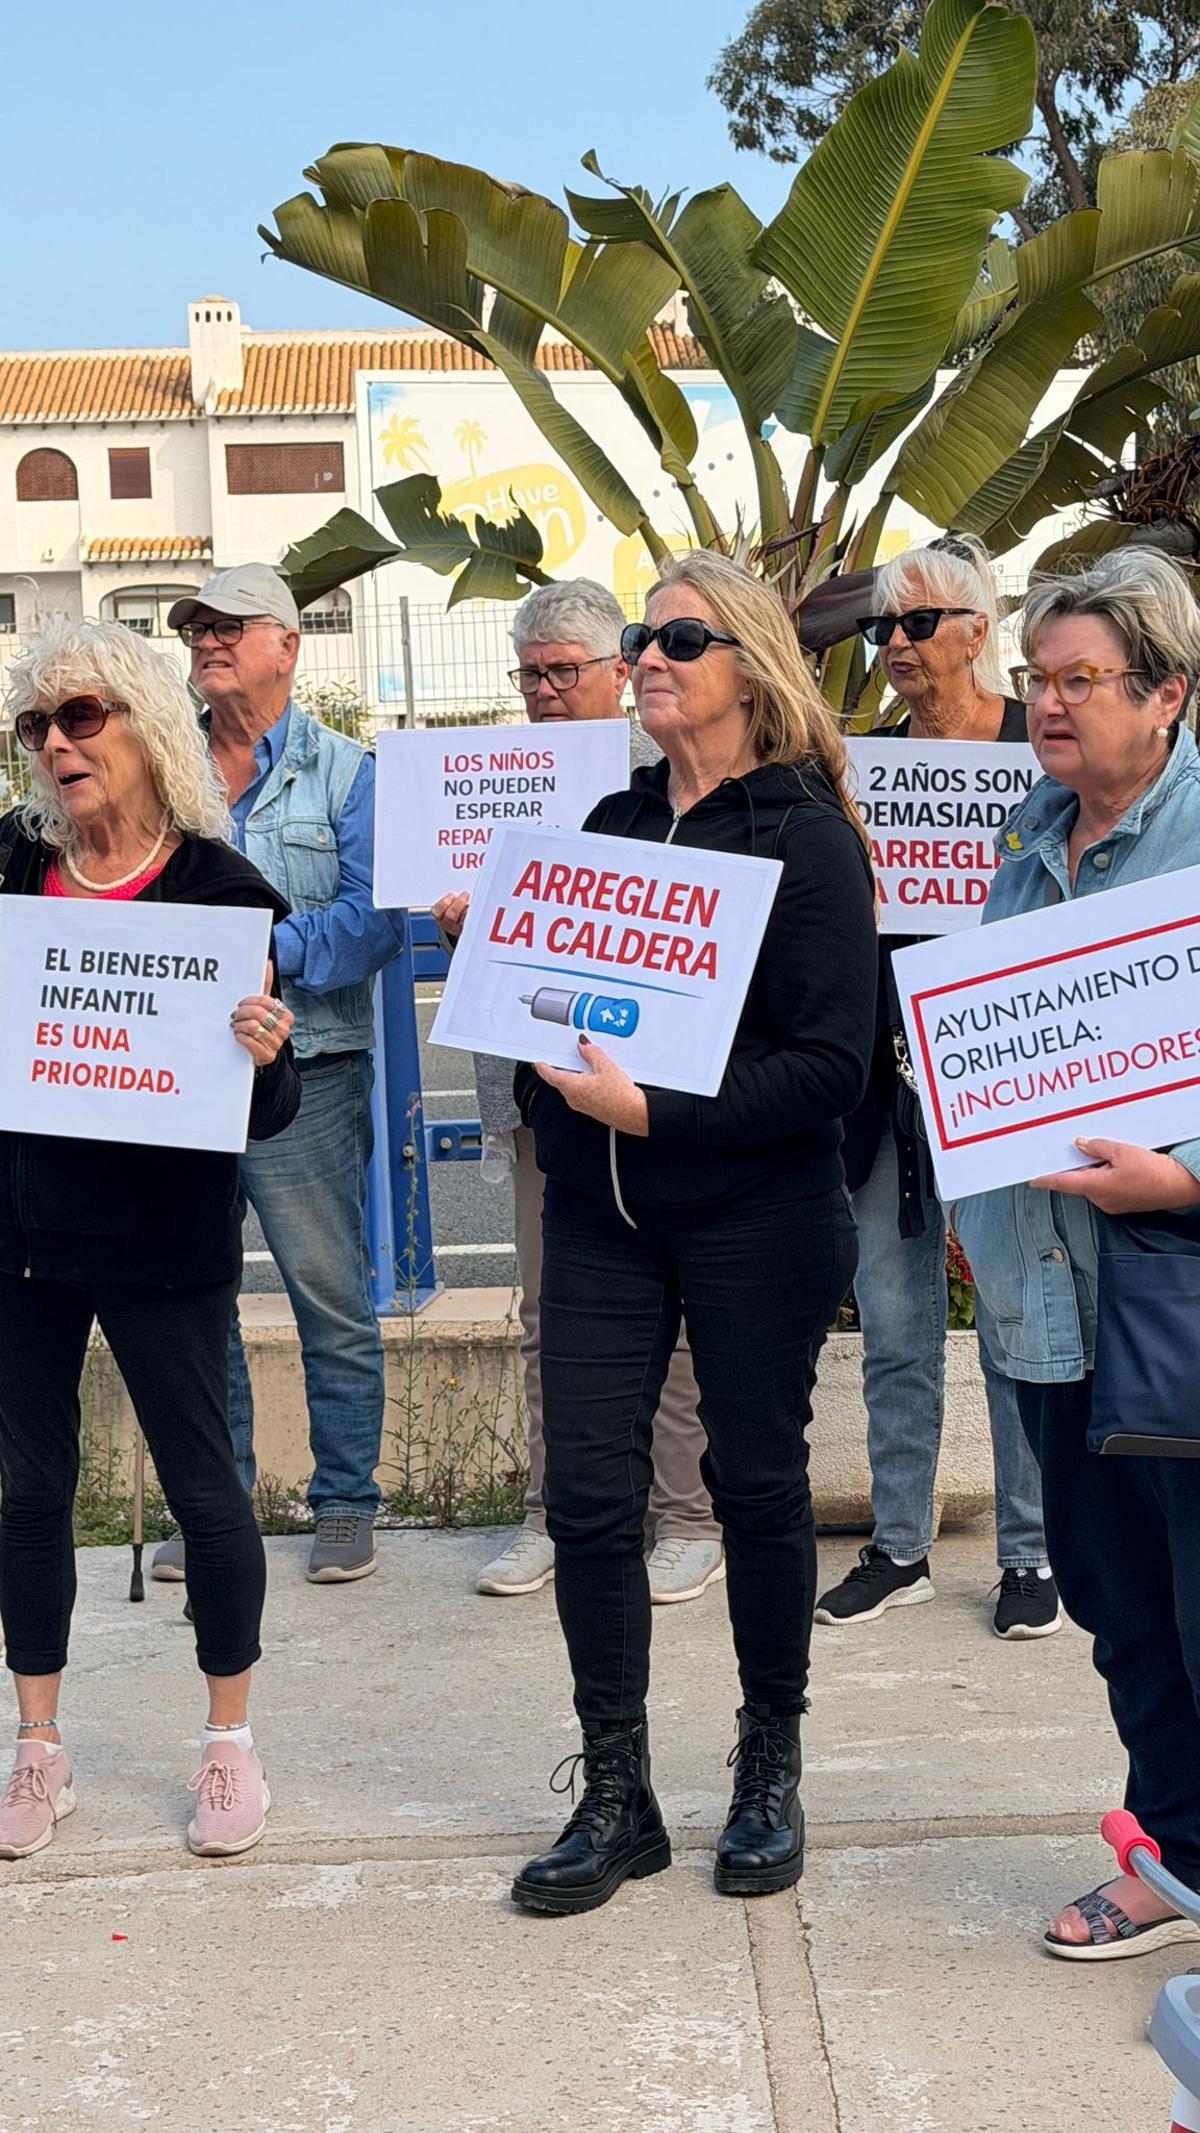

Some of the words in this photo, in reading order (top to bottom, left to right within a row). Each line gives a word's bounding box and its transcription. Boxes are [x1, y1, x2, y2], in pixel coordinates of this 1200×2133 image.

[486, 483, 560, 513] Have
[444, 753, 483, 773] LOS
[489, 747, 554, 772] NIÑOS
[444, 779, 473, 797] NO
[479, 776, 556, 795] PUEDEN
[869, 766, 887, 792] 2
[891, 762, 967, 793] AÑOS
[974, 769, 1033, 793] SON
[455, 800, 543, 820] ESPERAR
[512, 860, 721, 929] ARREGLEN
[898, 877, 992, 905] CALD
[488, 907, 535, 949] LA
[546, 916, 718, 980] CALDERA
[44, 947, 71, 972] EL
[80, 949, 219, 983] BIENESTAR
[40, 984, 159, 1016] INFANTIL
[934, 954, 1179, 1044] AYUNTAMIENTO
[36, 1022, 63, 1047] ES
[72, 1024, 130, 1052] UNA
[940, 1019, 1103, 1080] ORIHUELA:
[31, 1059, 180, 1095] PRIORIDAD.
